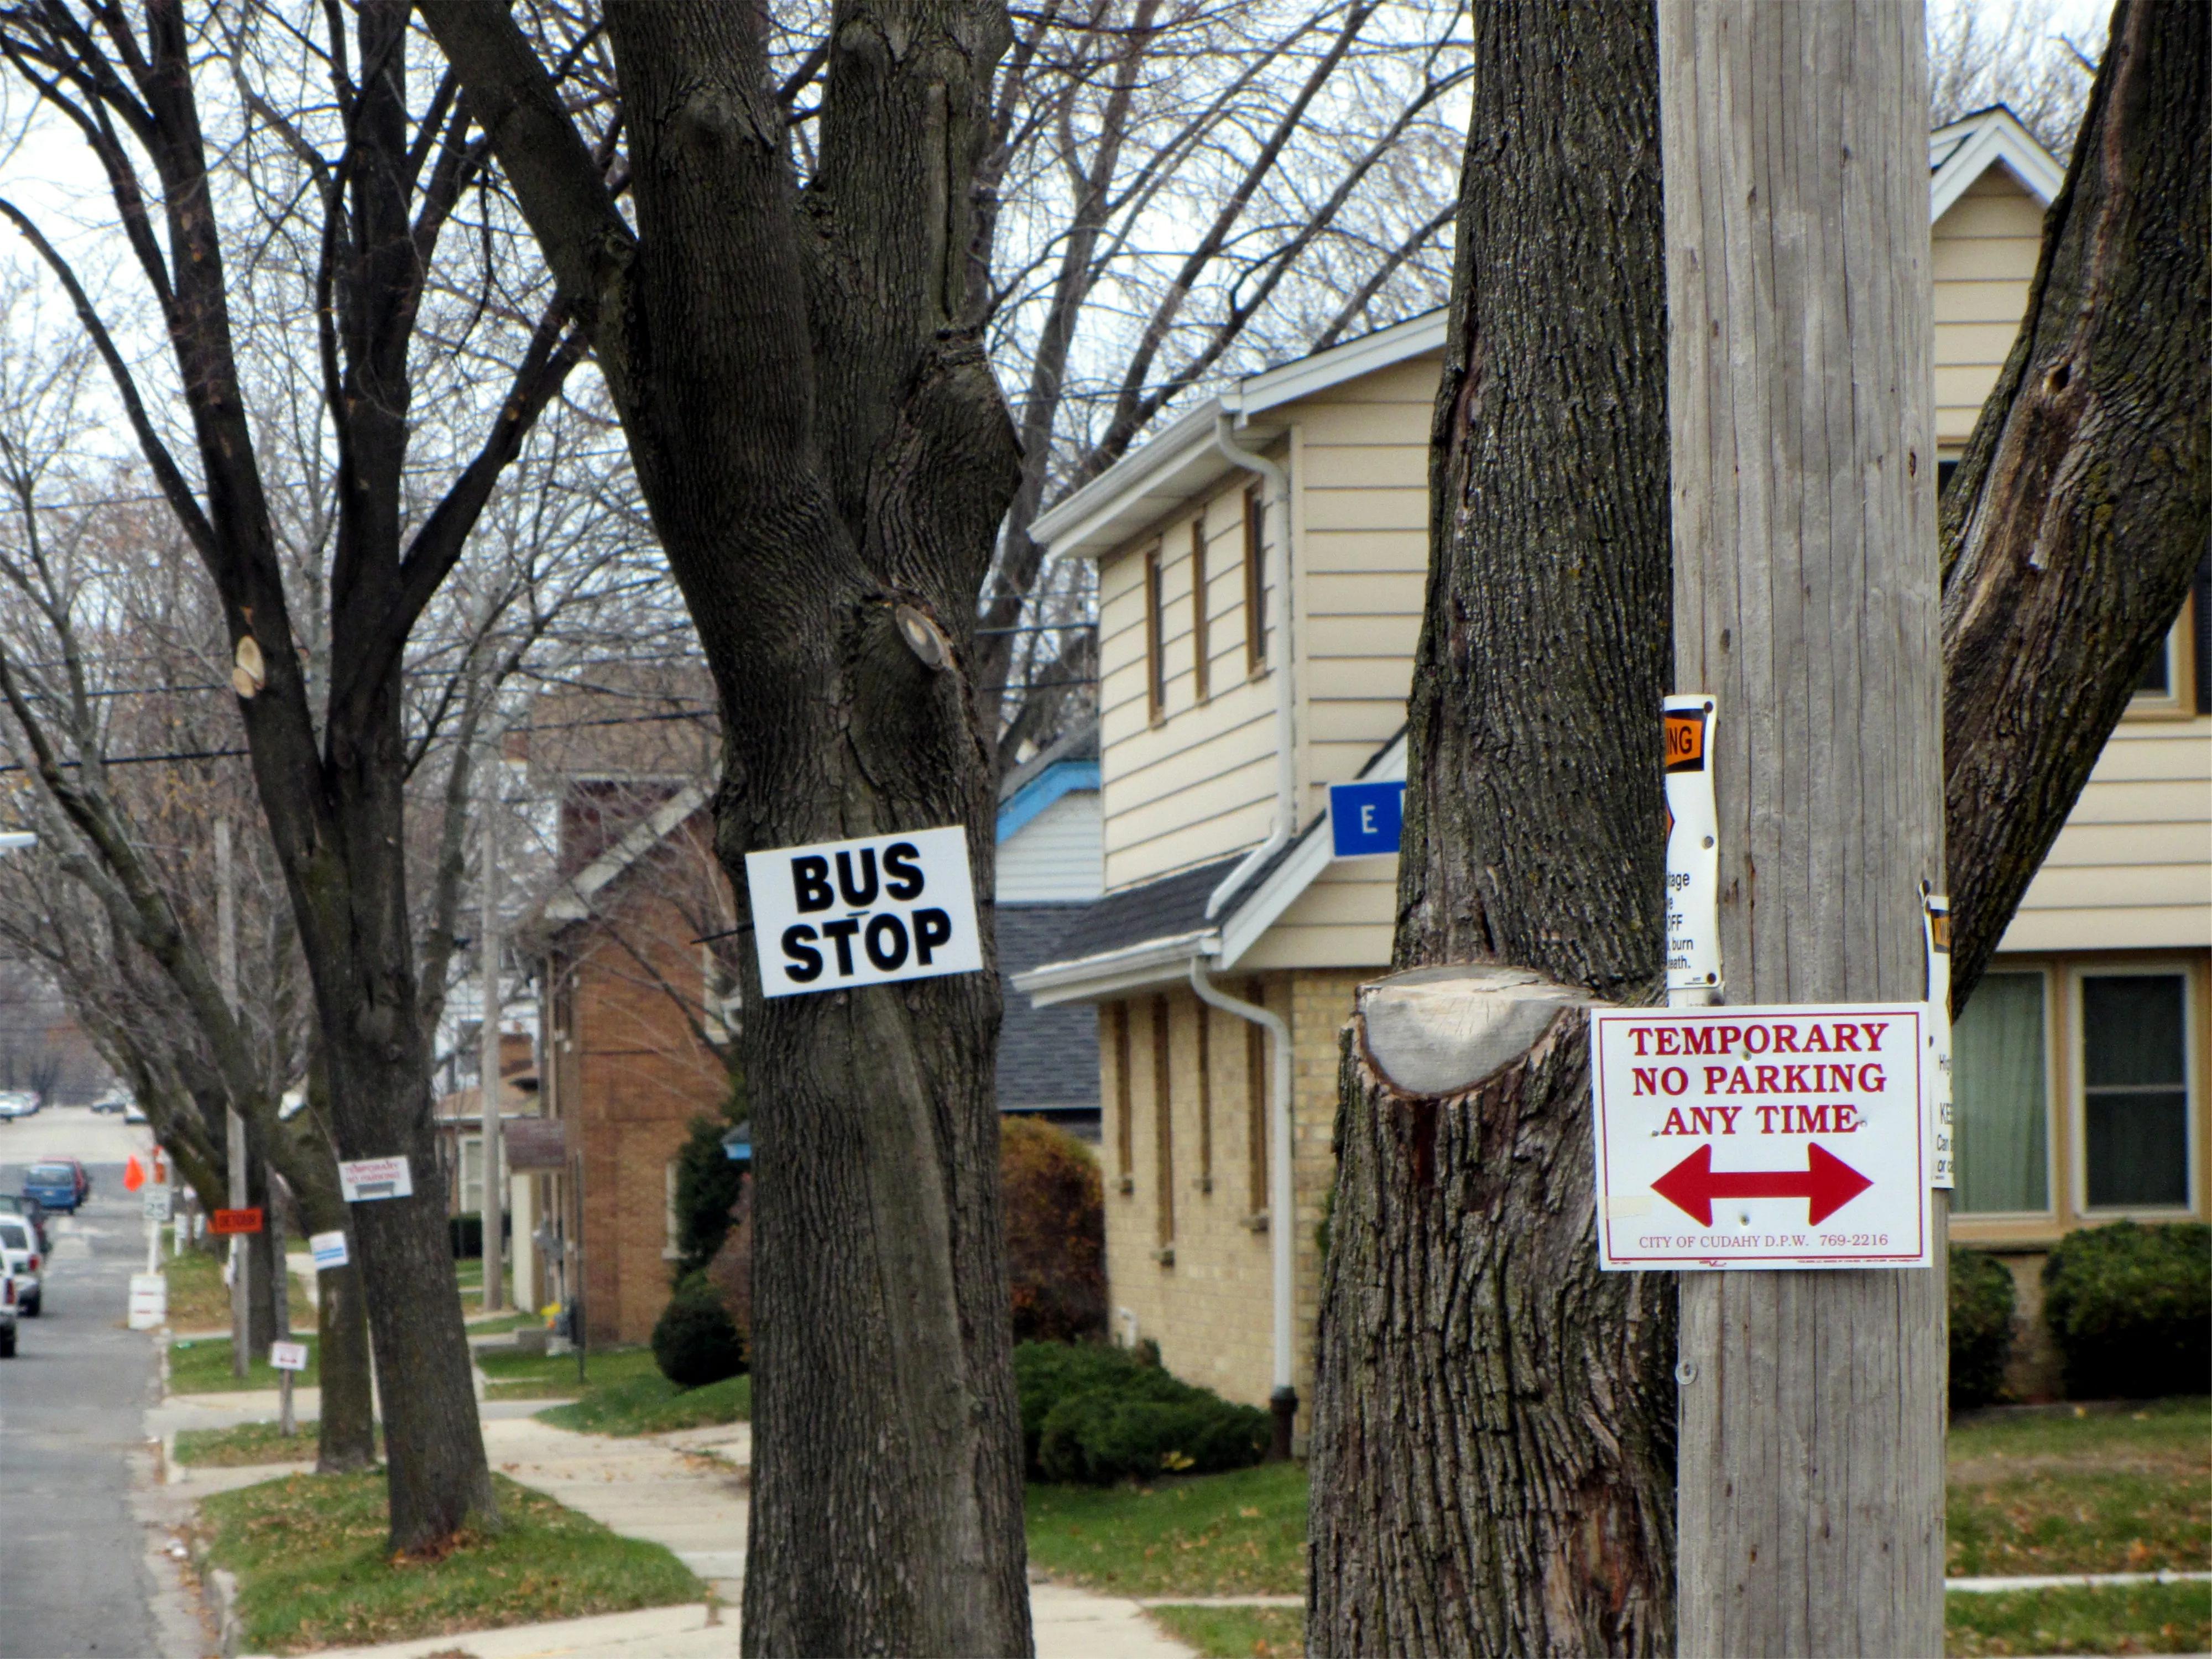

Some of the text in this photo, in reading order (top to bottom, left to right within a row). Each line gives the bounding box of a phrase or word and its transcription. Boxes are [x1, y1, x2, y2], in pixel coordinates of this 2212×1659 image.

[1361, 805, 1379, 834] E
[791, 842, 925, 914] BUS
[781, 907, 952, 984] STOP
[1672, 938, 1693, 951] burn
[1629, 1023, 1890, 1056] TEMPORARY
[1632, 1063, 1887, 1096] NO PARKING
[1661, 1104, 1859, 1136] ANY TIME
[1639, 1234, 1888, 1248] CITY OF CUDAHY D.P.W. 769-2216
